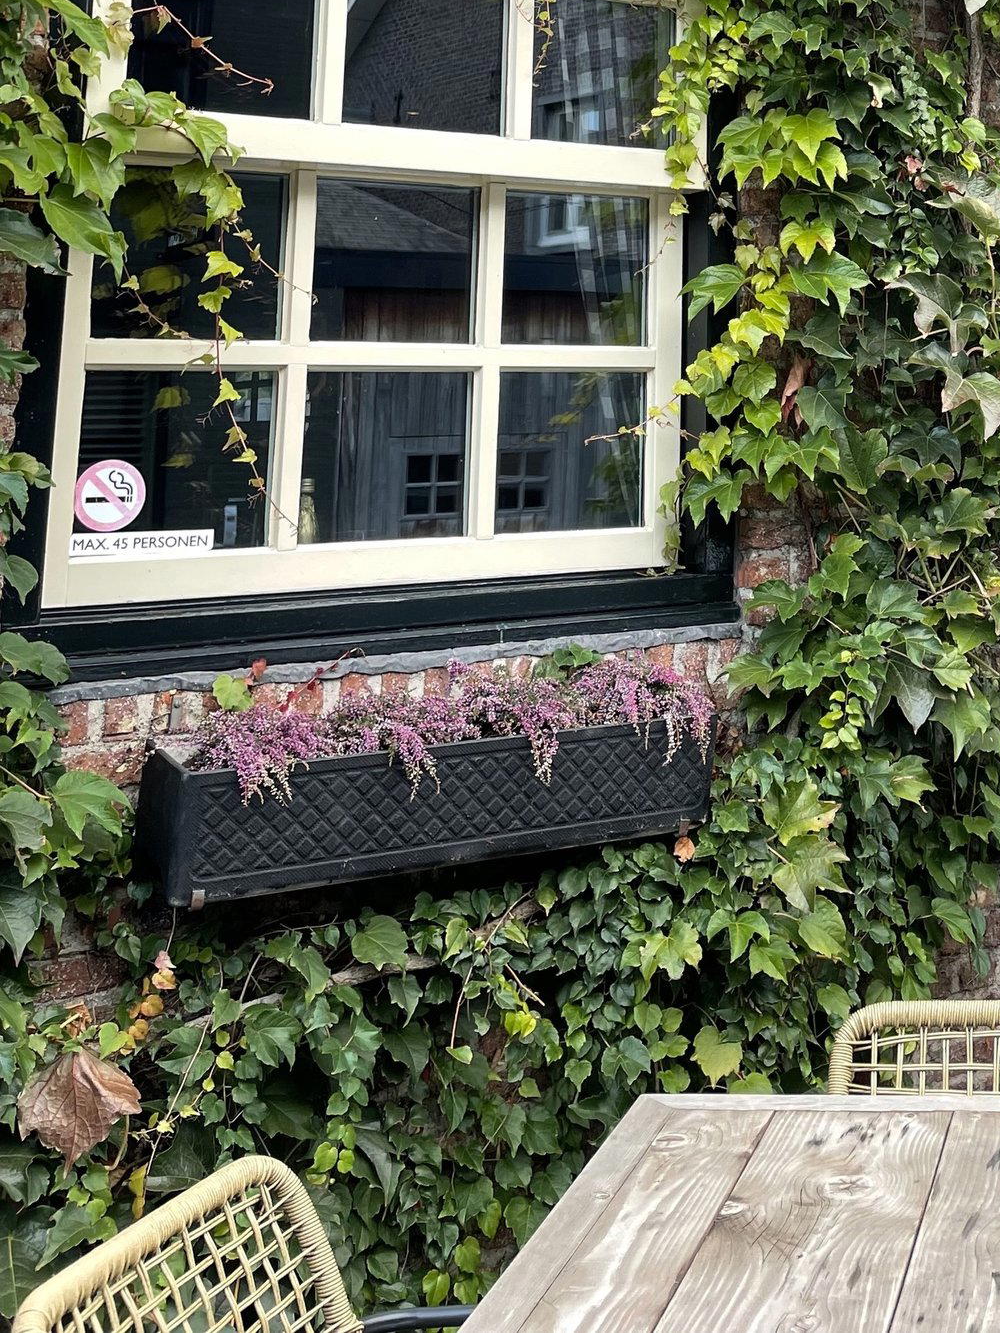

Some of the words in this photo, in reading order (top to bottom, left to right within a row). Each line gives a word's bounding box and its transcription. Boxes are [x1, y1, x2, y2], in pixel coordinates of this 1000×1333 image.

[72, 538, 110, 551] MAX.
[113, 537, 128, 549] 45
[133, 535, 208, 549] PERSONEN
